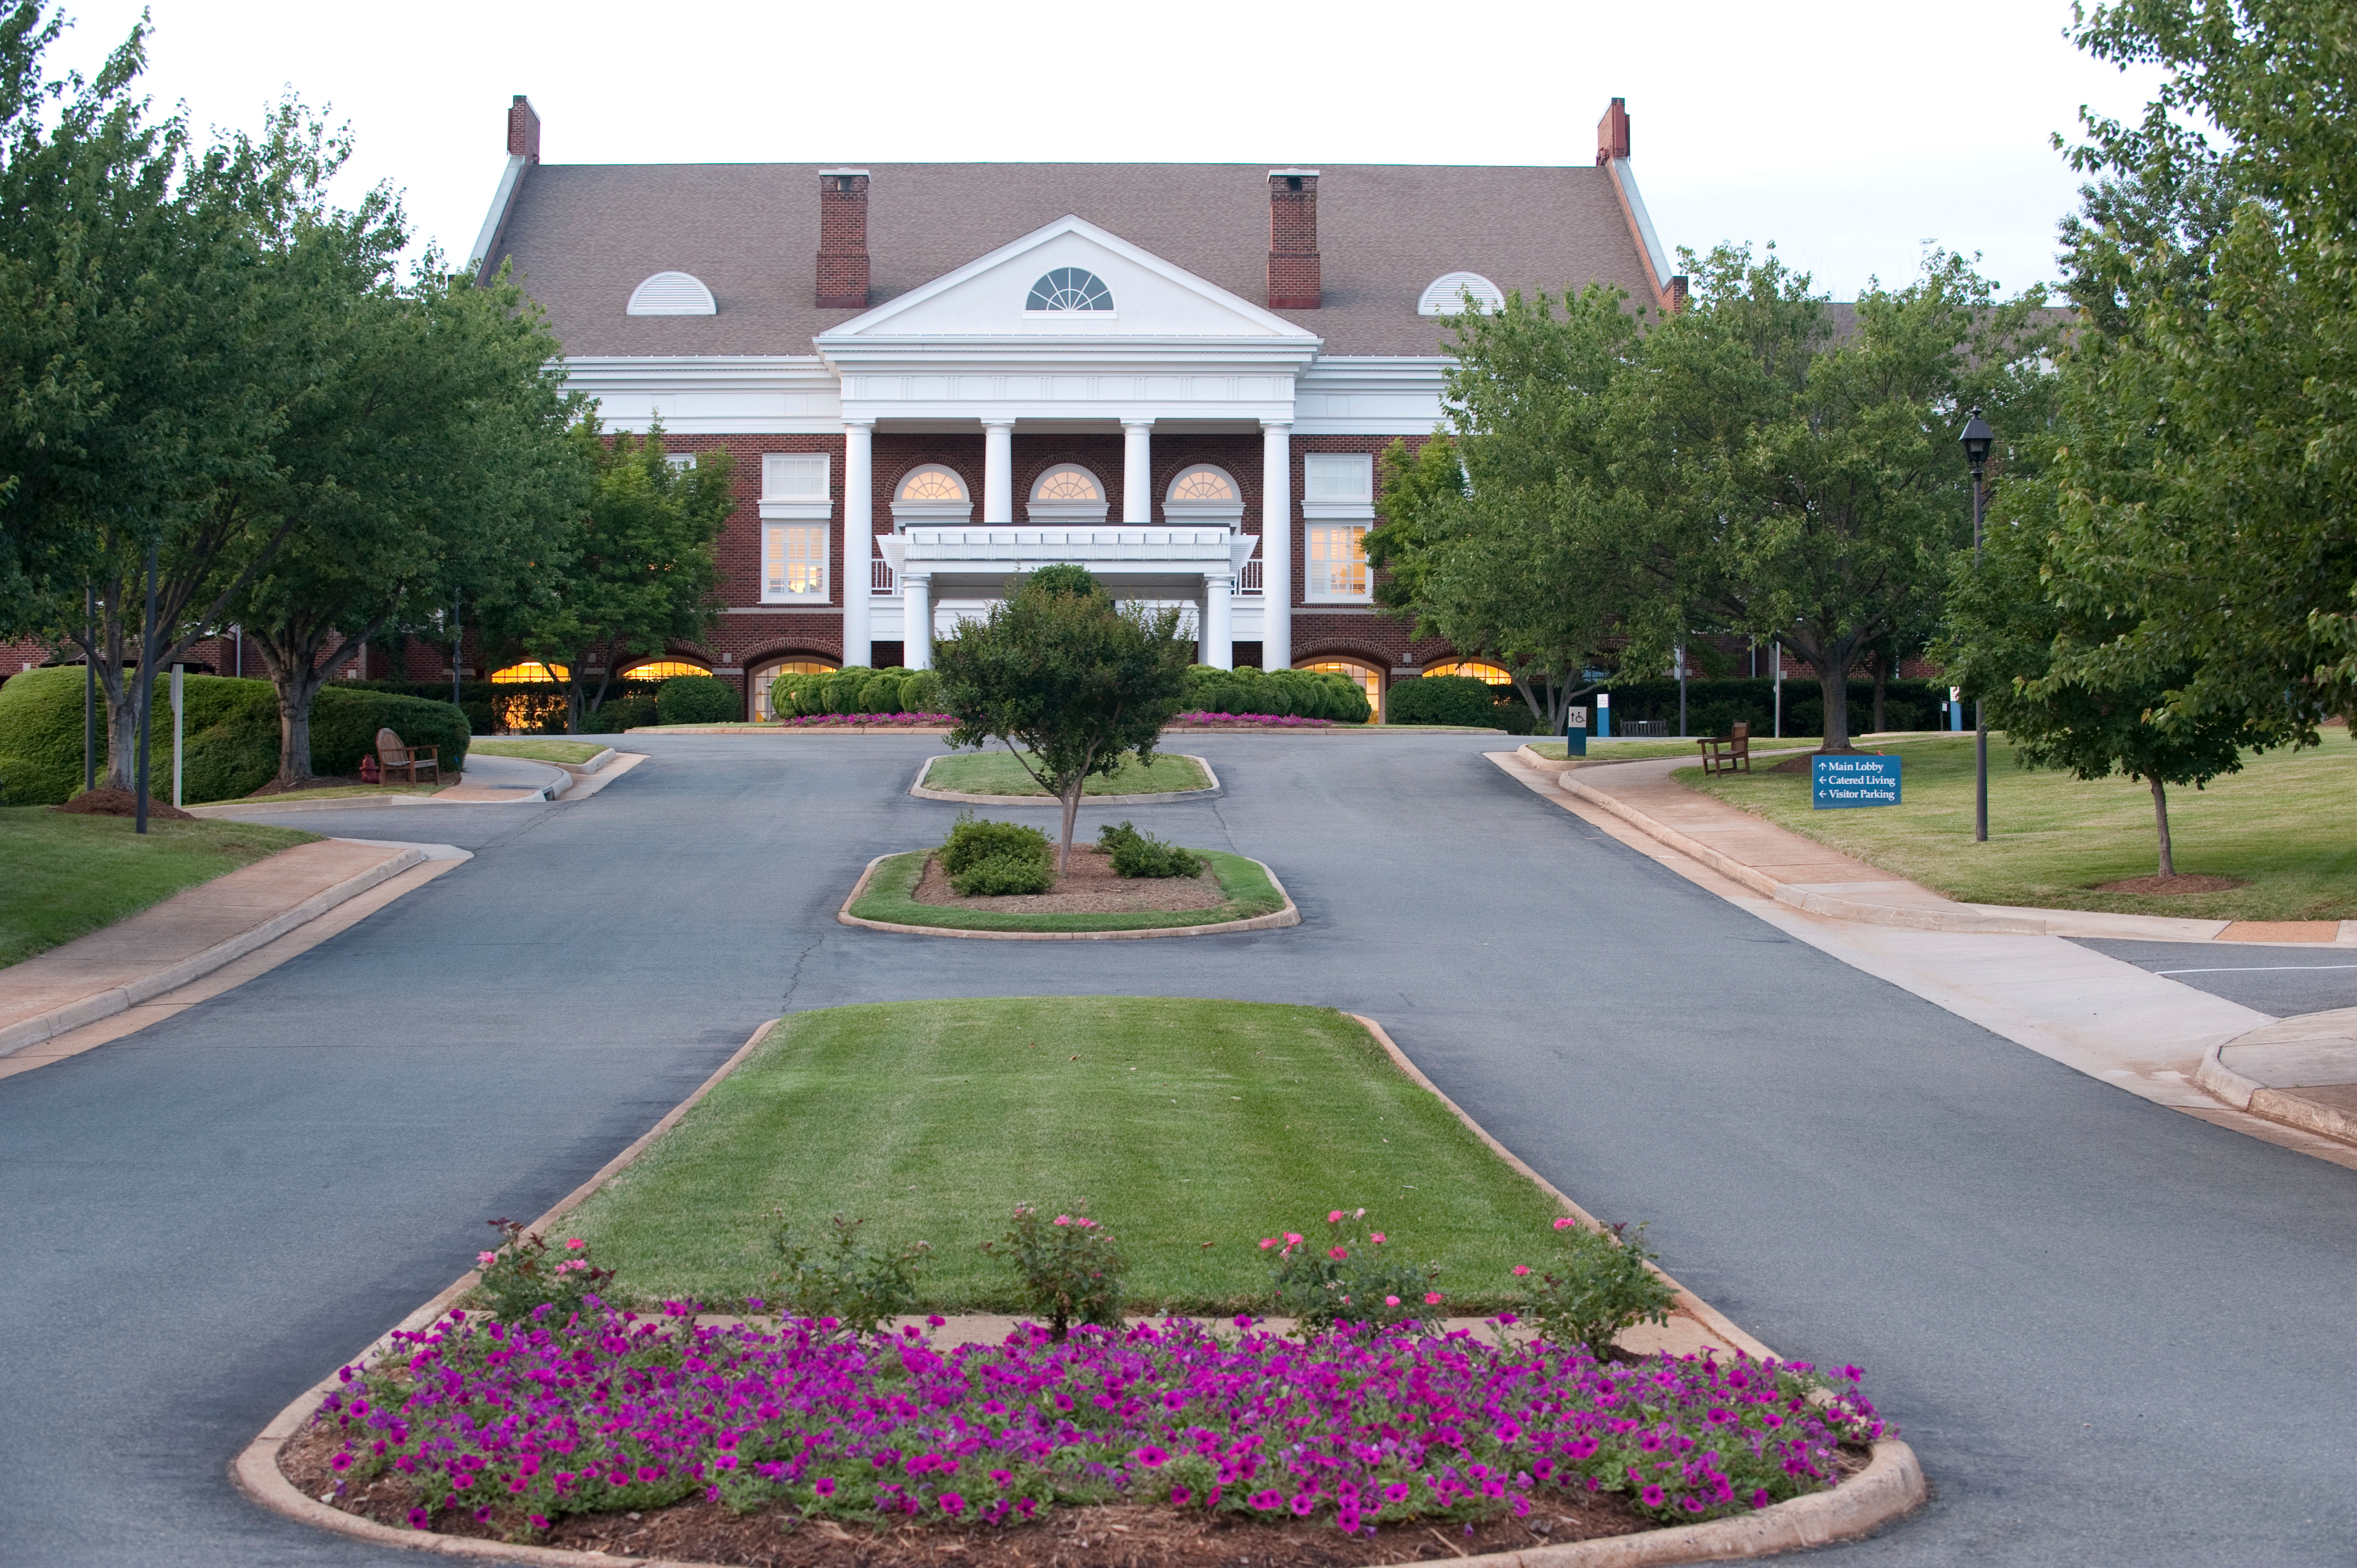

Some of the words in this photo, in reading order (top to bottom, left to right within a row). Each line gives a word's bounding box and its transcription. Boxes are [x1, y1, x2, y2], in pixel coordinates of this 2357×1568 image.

[1829, 762, 1854, 771] Main
[1855, 762, 1883, 773] Lobby
[1829, 776, 1864, 784] Catered
[1866, 776, 1896, 787] Living
[1829, 790, 1859, 798] Visitor
[1860, 790, 1895, 801] Parking
